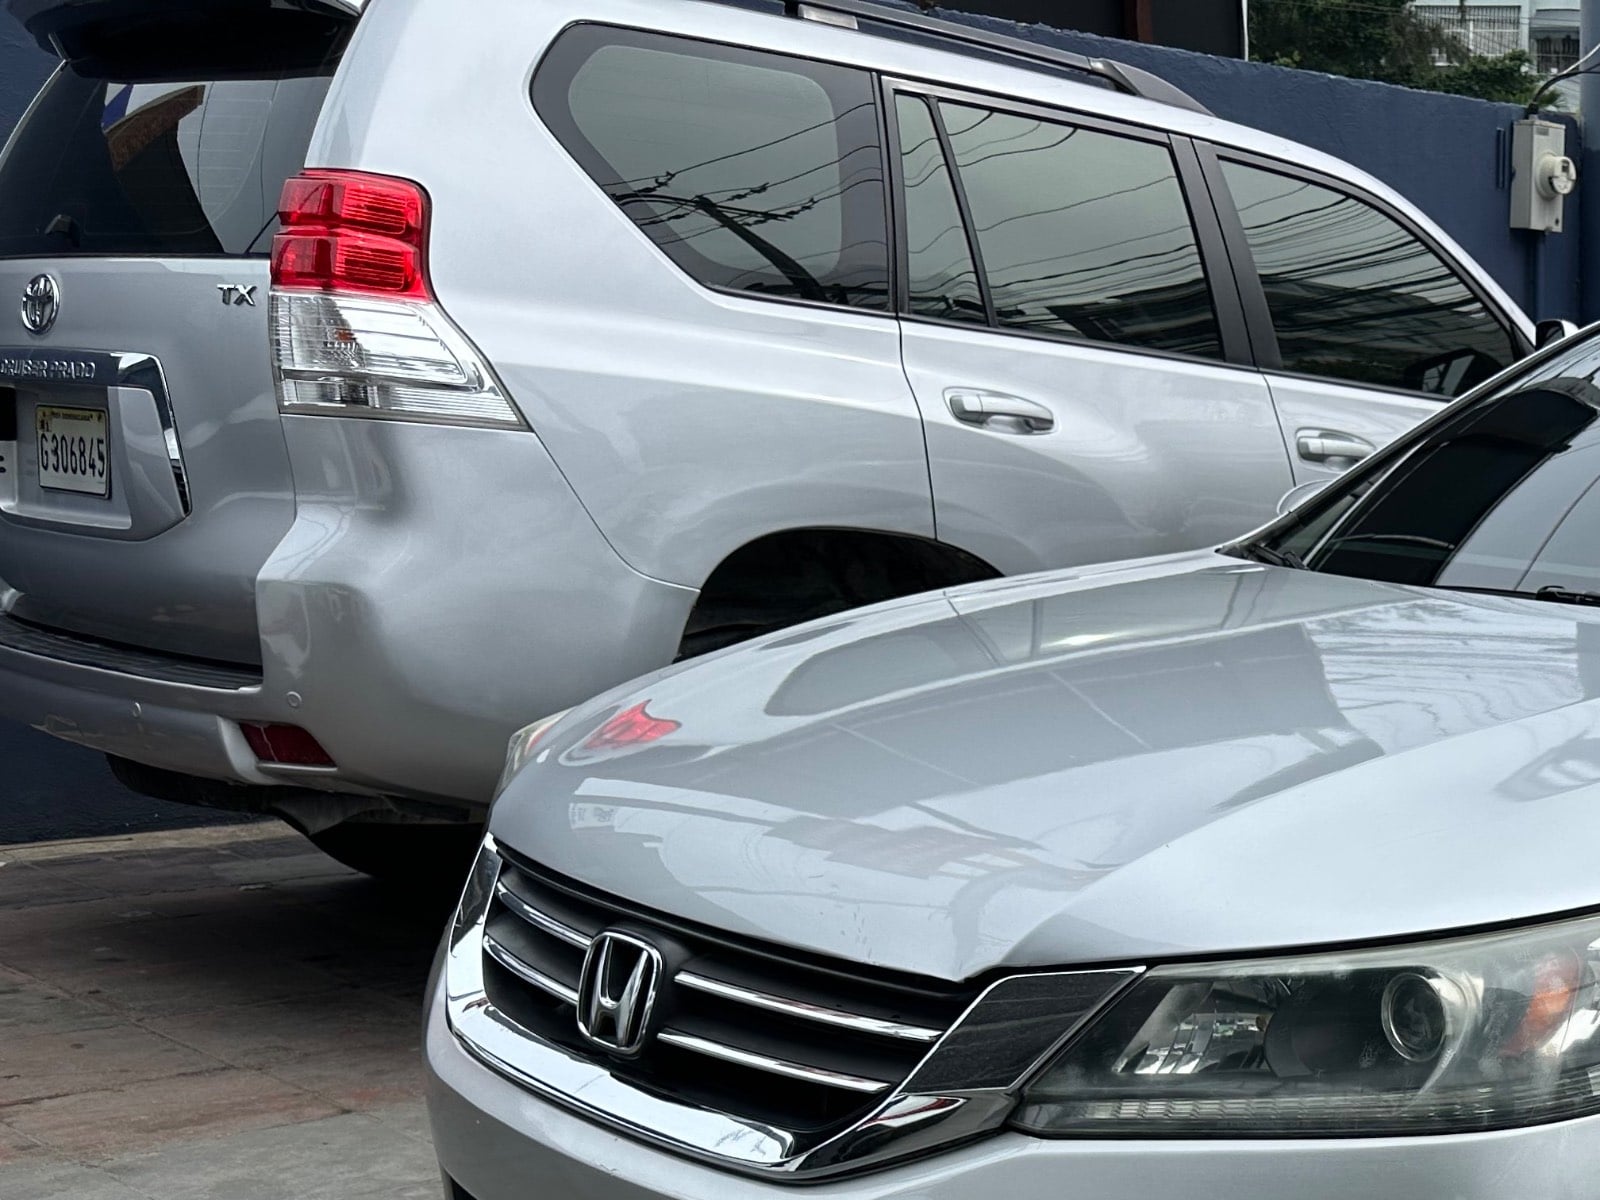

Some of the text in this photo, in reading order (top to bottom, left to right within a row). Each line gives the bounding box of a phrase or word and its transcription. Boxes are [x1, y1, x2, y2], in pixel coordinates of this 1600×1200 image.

[216, 284, 257, 307] TX
[50, 360, 96, 379] PRADO
[40, 433, 105, 479] G306845
